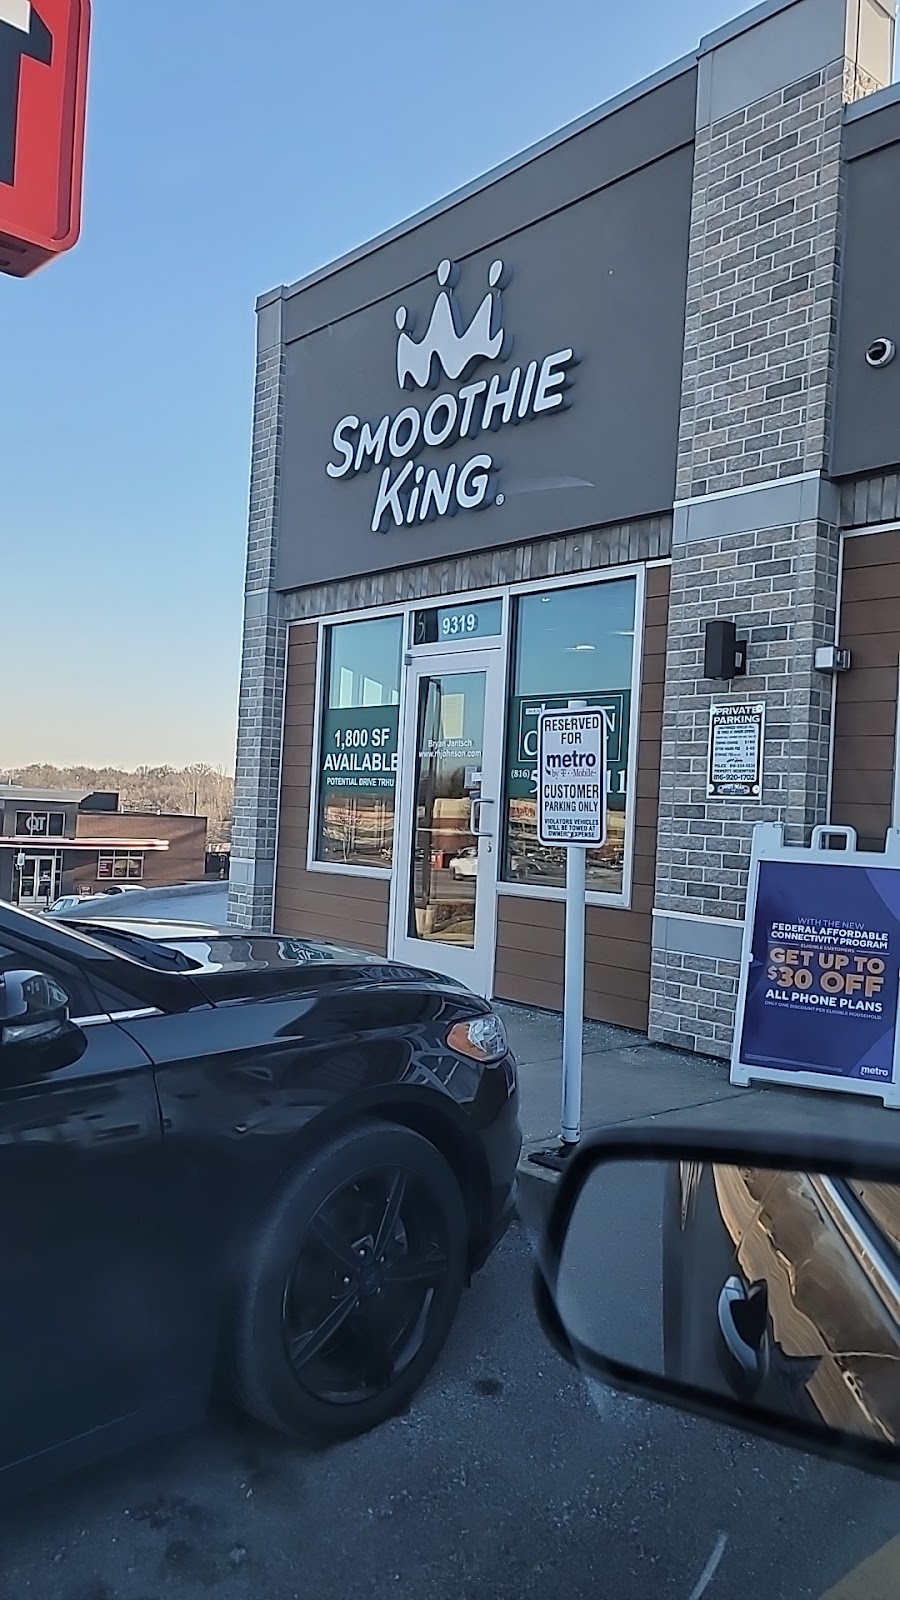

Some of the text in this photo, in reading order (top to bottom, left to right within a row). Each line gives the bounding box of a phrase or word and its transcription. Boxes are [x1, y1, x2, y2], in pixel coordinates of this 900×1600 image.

[326, 348, 573, 478] SMOOTHIE
[442, 613, 476, 635] 9319
[715, 706, 758, 715] PRIVATE
[544, 717, 599, 731] RESERVED
[714, 714, 760, 724] PARKING
[334, 728, 390, 750] 1,800 SF
[428, 739, 473, 750] Bryan Jantsch
[561, 732, 582, 744] FOR
[323, 752, 398, 771] AVAILABLE
[546, 750, 596, 767] metro
[326, 777, 358, 786] POTENTIAL
[359, 777, 377, 786] DRIVE
[511, 769, 530, 779] (816)
[552, 769, 559, 779] by
[544, 784, 599, 799] CUSTOMER
[544, 801, 599, 812] PARKING ONLY
[26, 816, 46, 831] QT
[797, 916, 865, 930] WITH THE NEW
[772, 922, 889, 941] FEDERAL AFFORDABLE
[771, 931, 888, 950] CONNECTIVITY PROGRAM
[769, 947, 885, 974] GET UP TO
[767, 965, 885, 998] $30 OFF
[765, 989, 883, 1013] ALL PHONE PLANS
[860, 1065, 889, 1076] metro
